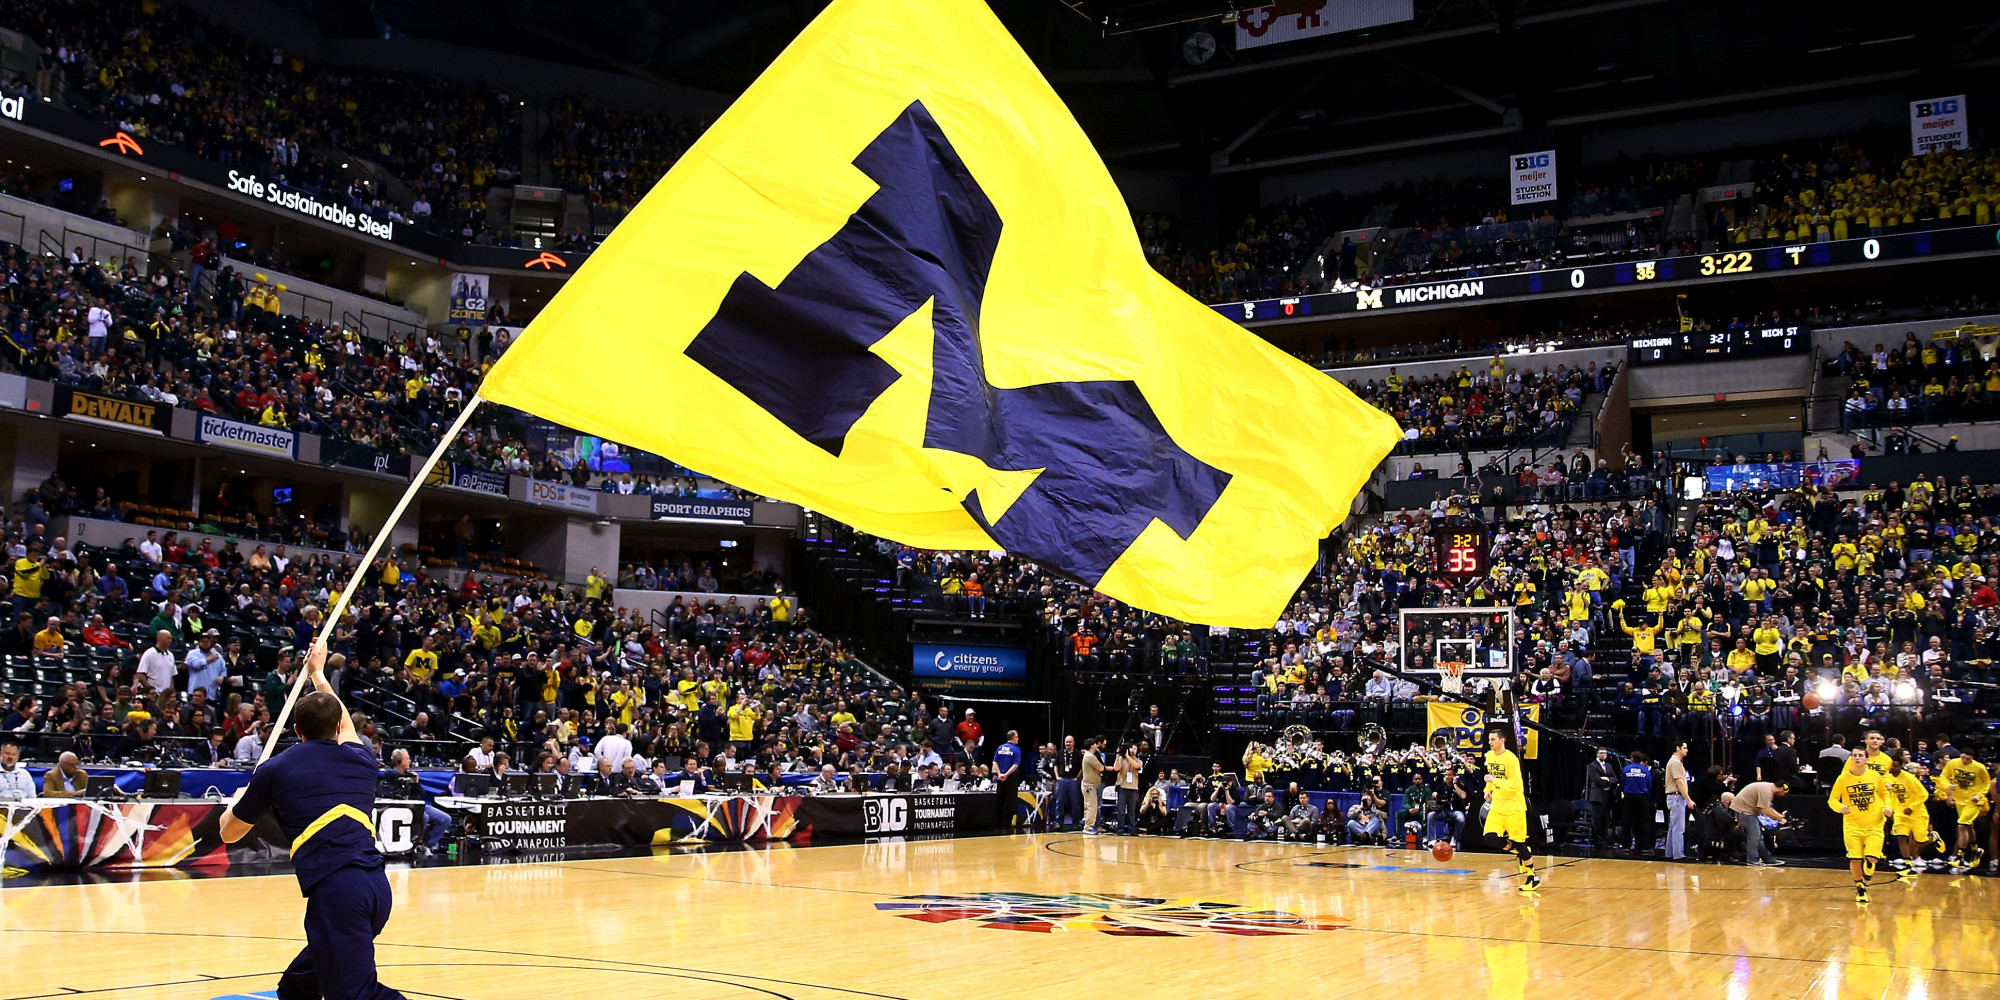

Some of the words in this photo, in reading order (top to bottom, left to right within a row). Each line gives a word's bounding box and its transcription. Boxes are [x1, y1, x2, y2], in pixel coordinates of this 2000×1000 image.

[1922, 118, 1956, 130] meijer
[1917, 132, 1962, 144] STUDENT
[1520, 171, 1547, 181] meijer
[1516, 184, 1552, 194] STUDENT
[1516, 191, 1551, 200] SECTION
[228, 170, 264, 198] Safe
[266, 183, 356, 228] Sustainable
[358, 213, 394, 240] Steel
[1863, 239, 1880, 260] 0
[1700, 252, 1752, 276] 3:22
[1791, 252, 1800, 266] 1
[1570, 268, 1584, 288] 0
[1636, 267, 1656, 280] 35
[1356, 289, 1384, 310] M
[1395, 281, 1484, 304] MICHIGAN
[465, 298, 486, 310] G2
[1285, 304, 1294, 316] 0
[1245, 308, 1254, 319] 5
[1633, 338, 1672, 348] MICHIGAN
[1710, 334, 1730, 344] 3:21
[1762, 329, 1783, 338] MICH
[1786, 327, 1798, 336] ST
[1784, 338, 1792, 348] 0
[1654, 348, 1661, 359] 0
[204, 419, 292, 449] ticketmaster
[374, 454, 389, 473] ipl
[533, 482, 557, 500] PDS
[653, 503, 692, 514] SPORT
[693, 505, 751, 517] GRAPHICS
[1453, 534, 1480, 548] 3:21
[1450, 548, 1477, 572] 35
[416, 656, 431, 669] M
[953, 653, 998, 665] citizens
[954, 664, 980, 673] energy
[982, 665, 1004, 674] group
[1853, 784, 1868, 792] THE
[914, 797, 955, 806] BASKETBALL
[1852, 796, 1870, 805] WAY
[488, 804, 567, 818] BASKETBALL
[914, 808, 955, 819] TOURNAMENT
[487, 819, 566, 835] TOURNAMENT
[914, 820, 954, 830] INDIANAPOLIS
